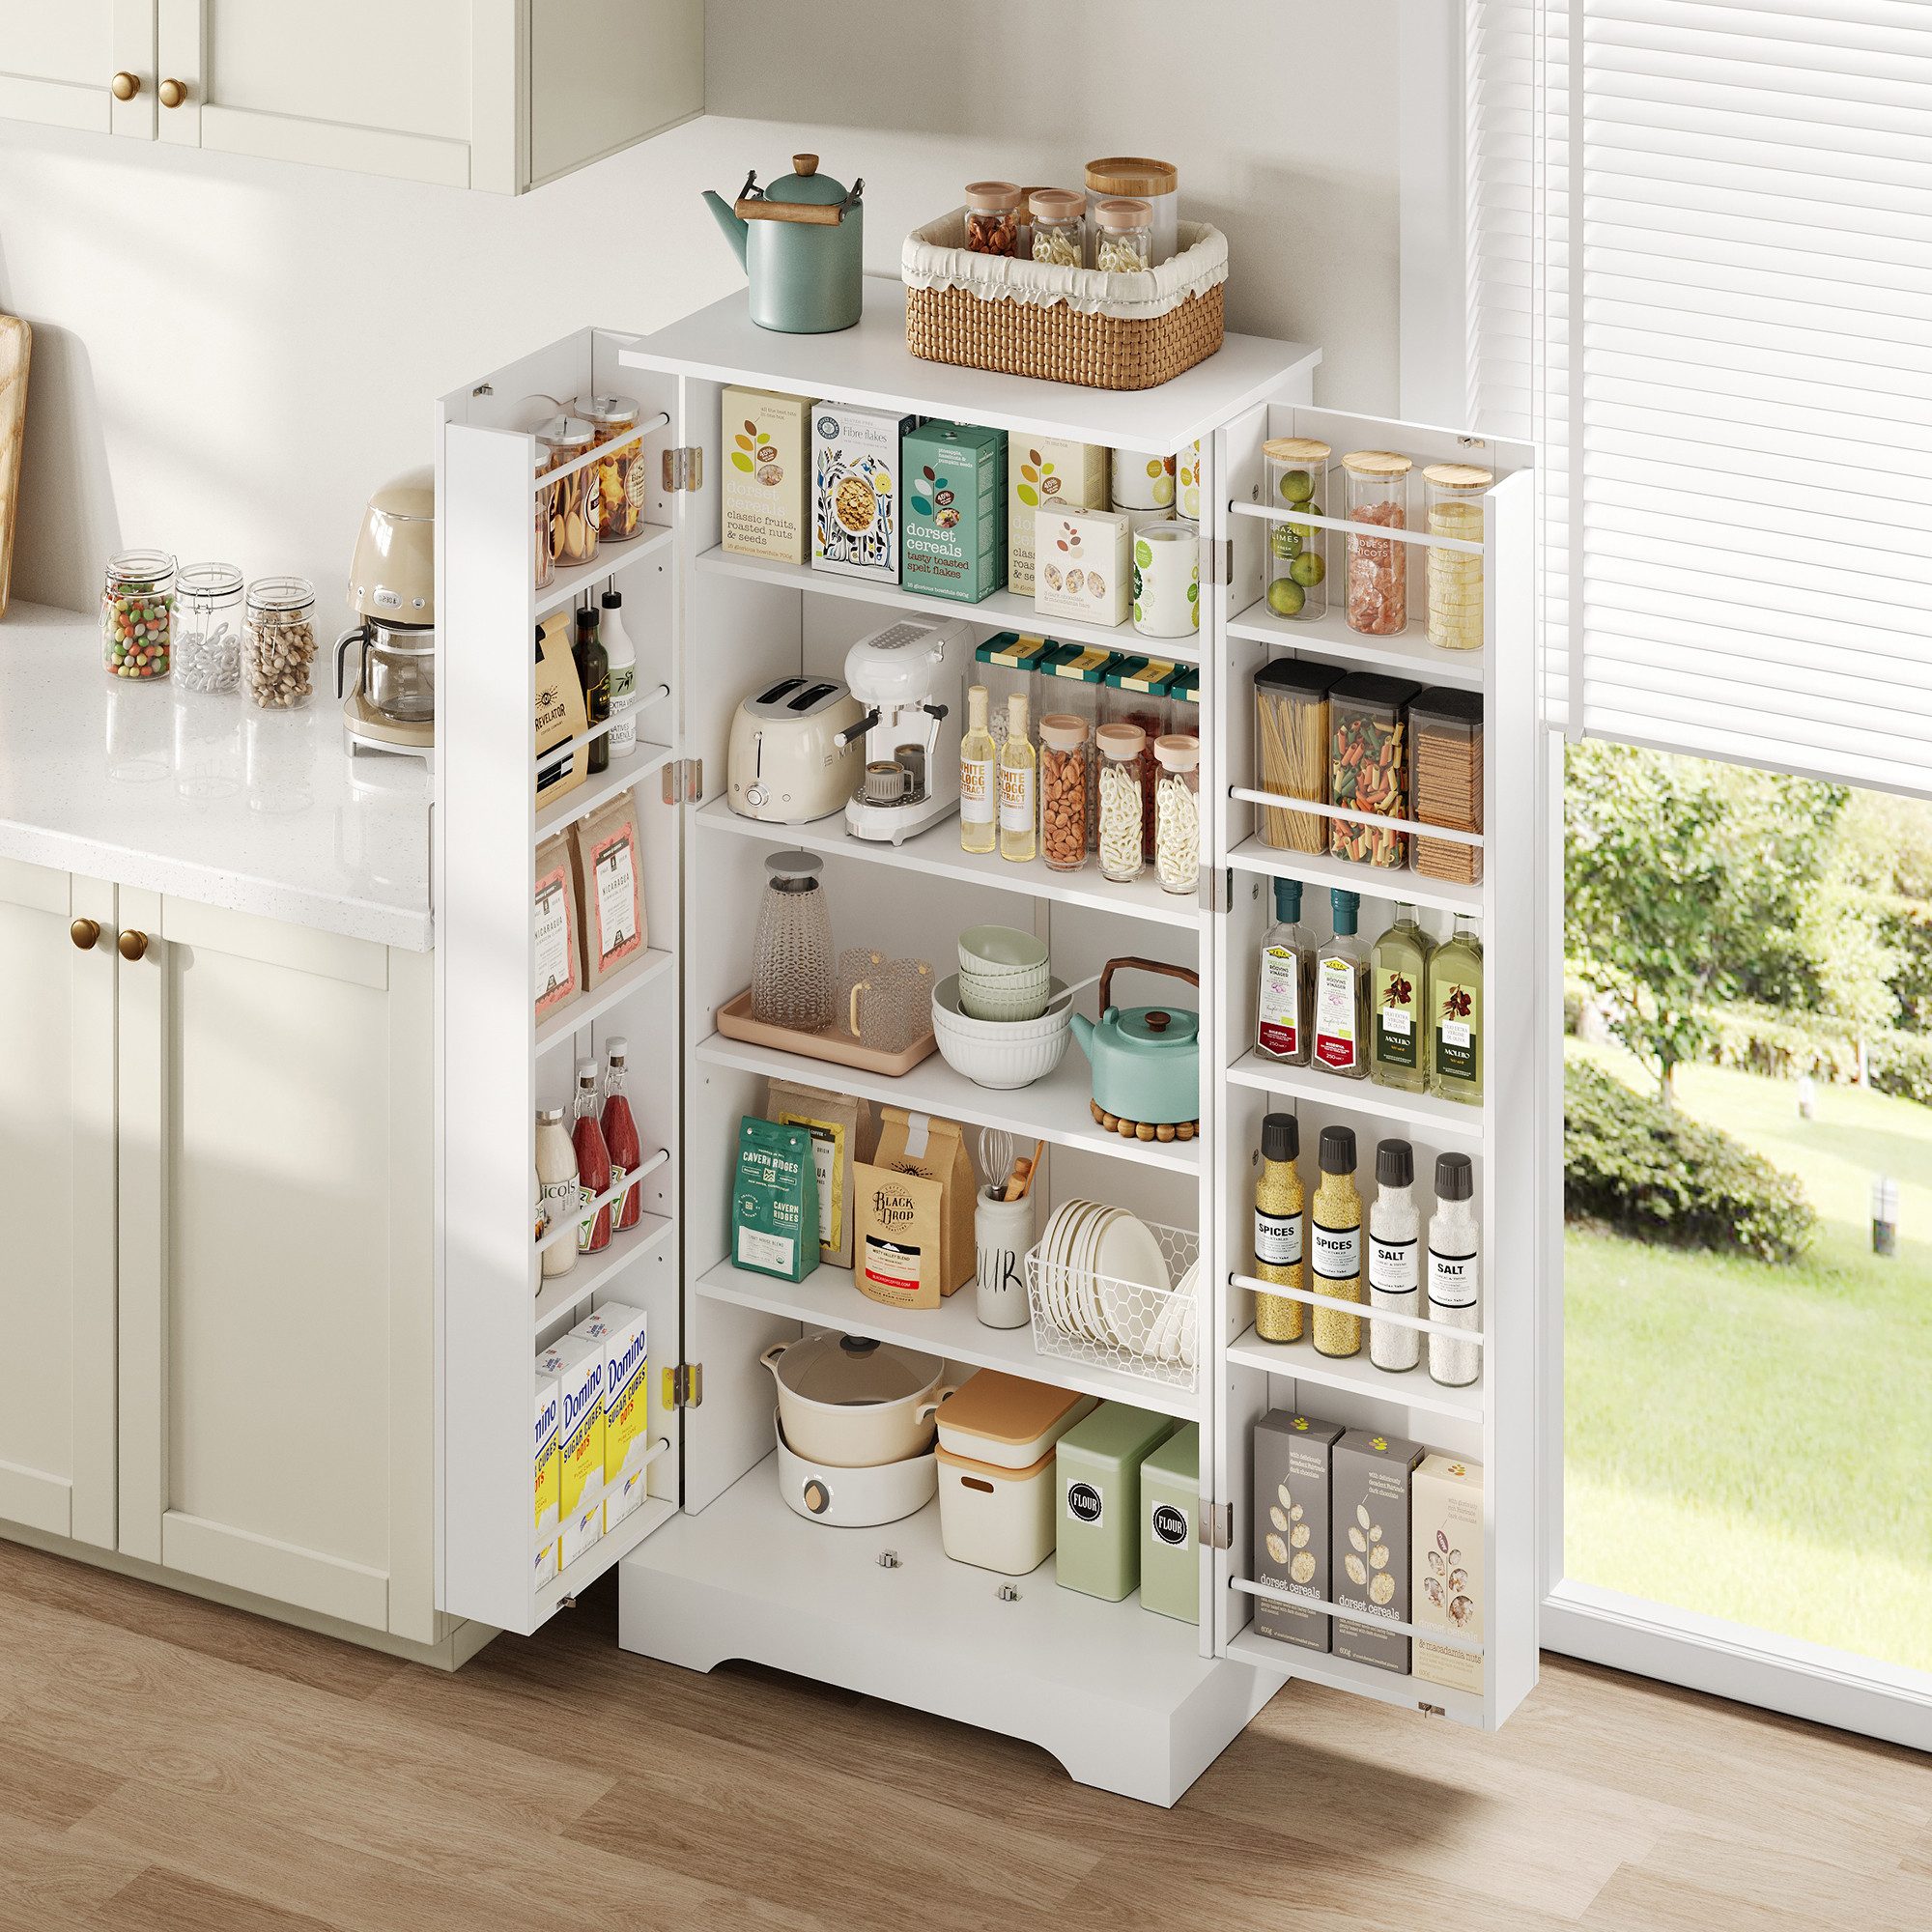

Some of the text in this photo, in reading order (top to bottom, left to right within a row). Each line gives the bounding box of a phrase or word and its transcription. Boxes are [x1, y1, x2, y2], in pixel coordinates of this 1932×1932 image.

[843, 426, 888, 443] Fibre flakes
[727, 480, 780, 502] dorset
[727, 497, 786, 517] cereals
[727, 511, 797, 531] classic fruits,
[727, 522, 793, 540] roasted nuts
[727, 530, 768, 546] & seeds
[906, 523, 956, 542] dorset
[1271, 533, 1299, 544] LIMES
[906, 538, 962, 557] cereals
[1013, 548, 1036, 559] clas
[907, 552, 969, 570] tasty toasted
[907, 562, 961, 579] spelt flakes
[1013, 559, 1035, 570] roas
[1013, 570, 1022, 579] &
[534, 703, 566, 731] REVELATOR
[602, 873, 630, 895] NICARAGUA
[743, 1151, 772, 1167] CAVERN
[772, 1158, 799, 1174] RIDGES
[544, 1180, 576, 1198] icols
[773, 1201, 799, 1213] CAVERN
[872, 1190, 914, 1211] BLACK
[773, 1209, 799, 1222] RIDGES
[882, 1208, 914, 1225] DROP
[1259, 1223, 1294, 1236] SPICES
[1316, 1236, 1352, 1250] SPICES
[1378, 1249, 1405, 1261] SALT
[1437, 1264, 1463, 1275] SALT
[608, 1330, 645, 1394] Domino
[563, 1364, 602, 1430] Domino
[608, 1367, 645, 1428] SUGAR CUBES
[535, 1400, 556, 1443] mino
[620, 1399, 634, 1426] DOTS
[563, 1401, 602, 1463] SUGAR CUBES
[539, 1436, 557, 1472] CUBES
[576, 1434, 590, 1462] DOTS
[535, 1470, 545, 1492] OTS
[1073, 1492, 1097, 1512] FLOUR
[1158, 1516, 1182, 1535] FLOUR
[1437, 1532, 1448, 1550] new
[1260, 1574, 1321, 1600] dorset cereals
[1339, 1595, 1400, 1621] dorset cereals
[1418, 1638, 1482, 1664] & macadamia nuts
